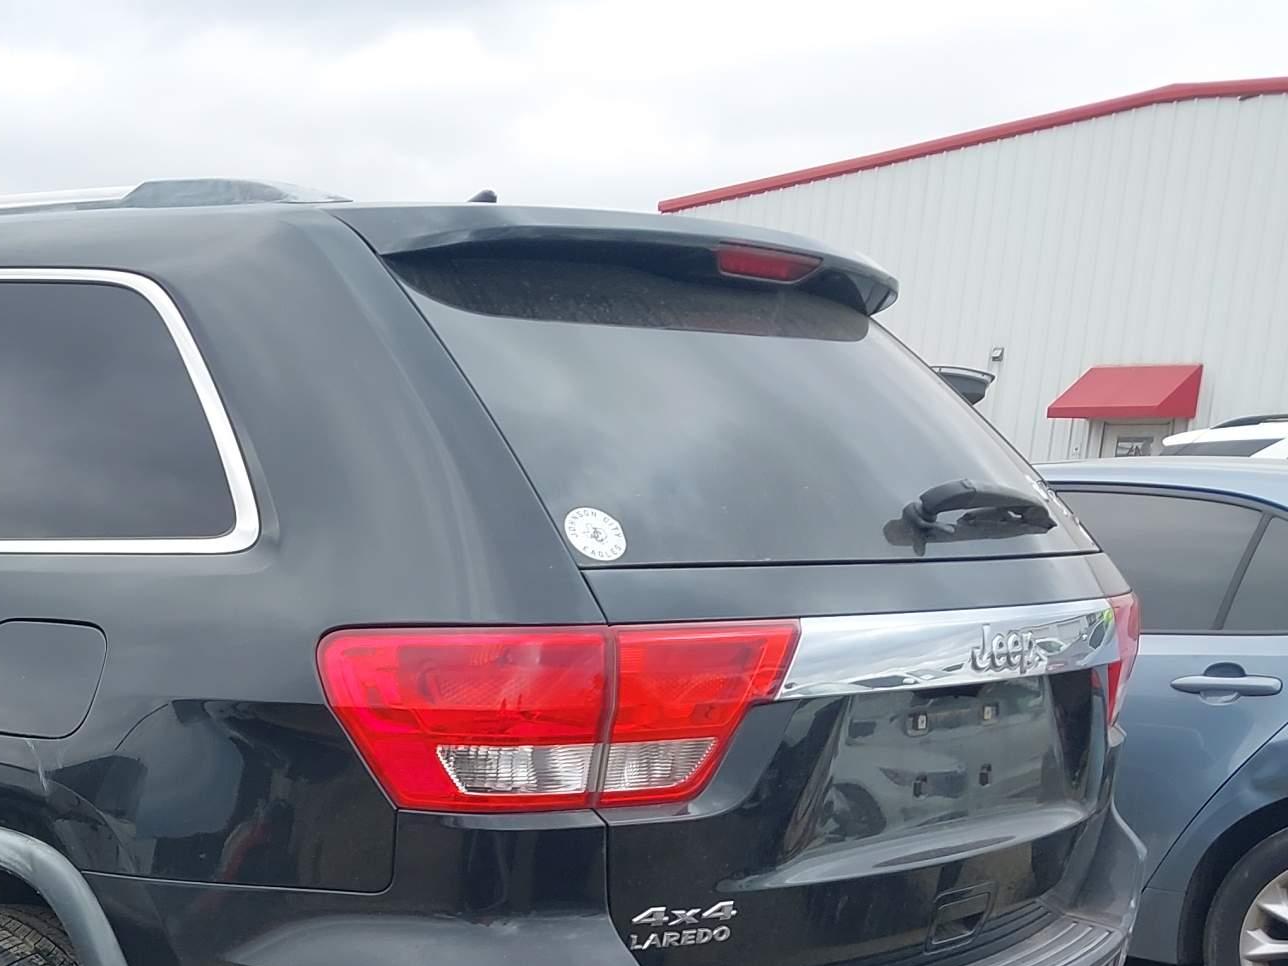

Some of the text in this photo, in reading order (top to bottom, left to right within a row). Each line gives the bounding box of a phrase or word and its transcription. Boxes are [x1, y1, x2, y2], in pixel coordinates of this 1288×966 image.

[602, 516, 623, 538] CITY
[582, 543, 623, 558] EAGLES
[970, 623, 1038, 674] Jeep
[631, 900, 738, 926] 4x4
[629, 925, 731, 950] LAREDO
